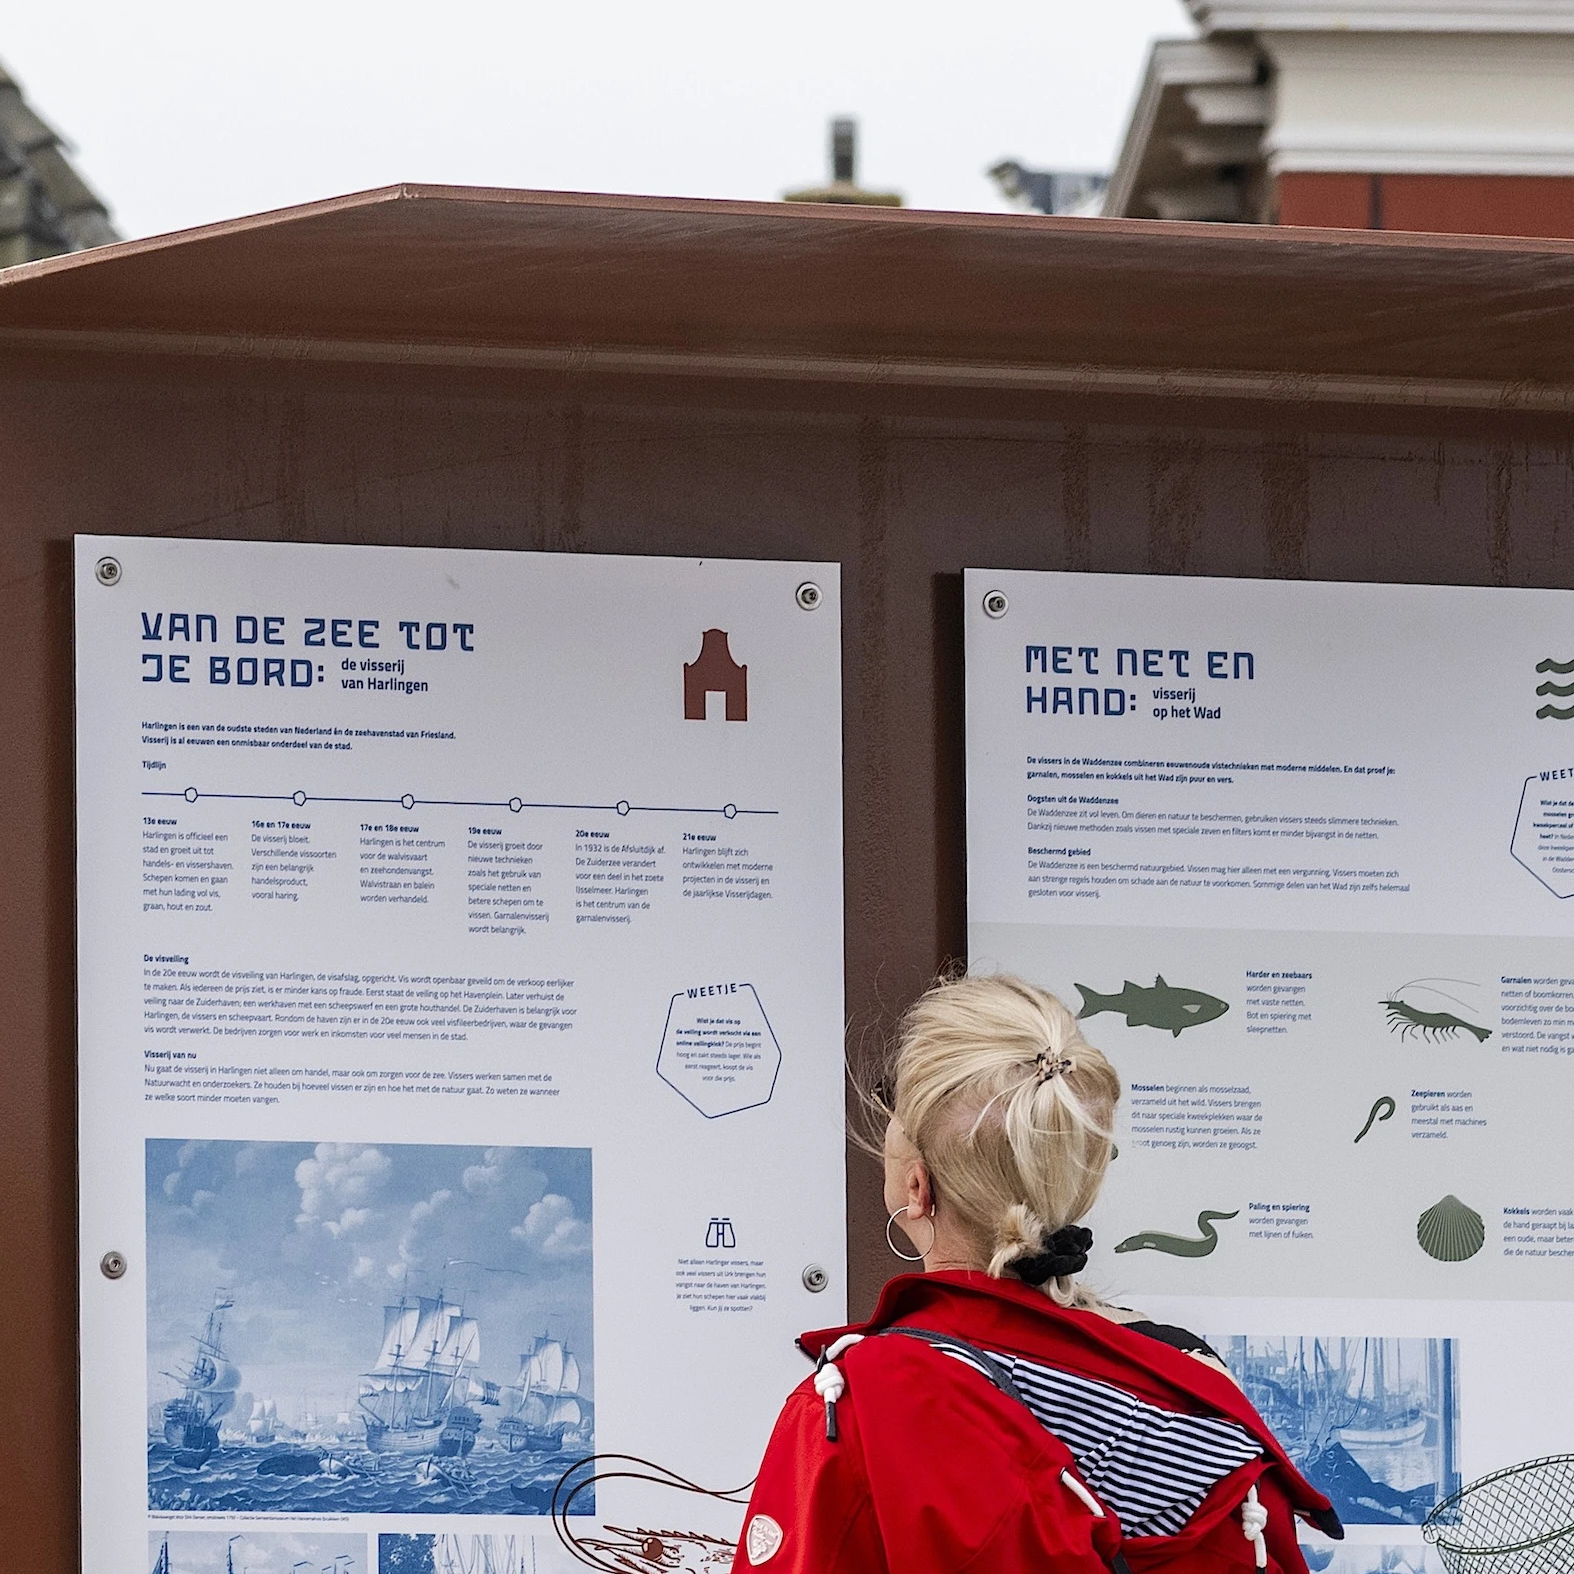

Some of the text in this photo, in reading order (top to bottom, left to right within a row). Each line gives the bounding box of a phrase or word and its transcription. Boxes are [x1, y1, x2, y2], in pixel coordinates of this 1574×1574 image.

[140, 611, 474, 652] VAN DE ZEE TOT
[340, 657, 405, 675] de visserij
[1025, 645, 1254, 680] MET NET EN
[141, 653, 325, 688] JE BORD:
[340, 677, 429, 695] van Harlingen
[1025, 685, 1137, 716] HAND:
[1151, 686, 1197, 703] visserij
[1152, 705, 1221, 721] op het Wad
[141, 721, 178, 732] Harlingen
[178, 722, 185, 730] is
[215, 723, 226, 732] de
[226, 724, 252, 733] oudste
[253, 725, 279, 734] steden
[294, 726, 332, 735] Nederland
[343, 728, 354, 736] de
[354, 728, 405, 738] zeehavenstad
[420, 730, 456, 740] Friesland.
[141, 735, 169, 746] Visserij
[169, 736, 177, 744] is
[177, 736, 185, 744] al
[230, 738, 270, 747] onmisbaar
[270, 739, 308, 748] onderdeel
[323, 741, 333, 749] de
[333, 741, 353, 750] stad.
[141, 760, 167, 771] Tijdlijn
[1026, 756, 1037, 764] De
[1037, 756, 1063, 765] vissers
[1071, 757, 1081, 765] de
[1081, 757, 1123, 766] Waddenzee
[1123, 758, 1165, 768] combineren
[1165, 760, 1211, 769] eeuwenoude
[1211, 761, 1260, 770] vistechnieken
[1260, 763, 1275, 771] met
[1275, 763, 1307, 772] moderne
[1307, 764, 1343, 773] middelen.
[1343, 765, 1353, 773] En
[1353, 765, 1366, 774] dat
[1366, 765, 1386, 775] proef
[1026, 770, 1060, 780] garnalen,
[1060, 770, 1095, 780] mosselen
[1105, 772, 1133, 780] kokkels
[1133, 773, 1144, 781] uit
[1144, 773, 1157, 781] het
[1157, 773, 1175, 782] Wad
[1175, 774, 1188, 784] zijn
[1188, 776, 1206, 784] puur
[1026, 794, 1119, 805] Oogsten uit de Waddenzee
[142, 816, 157, 825] 13e
[251, 820, 265, 828] 16e
[276, 820, 290, 829] 17e
[359, 823, 373, 831] 17e
[384, 824, 399, 832] 18e
[467, 826, 481, 835] 19e
[575, 829, 589, 838] 20e
[142, 830, 177, 842] Harlingen
[177, 831, 185, 840] is
[185, 831, 214, 841] officieel
[681, 832, 696, 841] 21e
[142, 844, 214, 856] stad en groeit uit tot
[574, 843, 666, 856] In 1932 is de Afsluitdijk af.
[1027, 846, 1091, 858] Beschermd gebied
[142, 858, 174, 868] handels-
[185, 860, 233, 870] vissershaven.
[144, 955, 189, 965] De visveiling
[1245, 970, 1270, 978] Harder
[1281, 970, 1313, 979] zeebaars
[1499, 975, 1533, 984] Garnalen
[687, 982, 738, 999] WEETJE
[1246, 983, 1306, 995] worden gevangen
[1261, 998, 1280, 1006] vaste
[143, 1050, 171, 1060] Visserij
[1130, 1083, 1165, 1092] Mosselen
[1410, 1089, 1446, 1099] Zeepieren
[1248, 1202, 1271, 1212] Paling
[1281, 1203, 1310, 1213] spiering
[1502, 1206, 1531, 1215] Kokkels
[1248, 1216, 1309, 1227] worden gevangen
